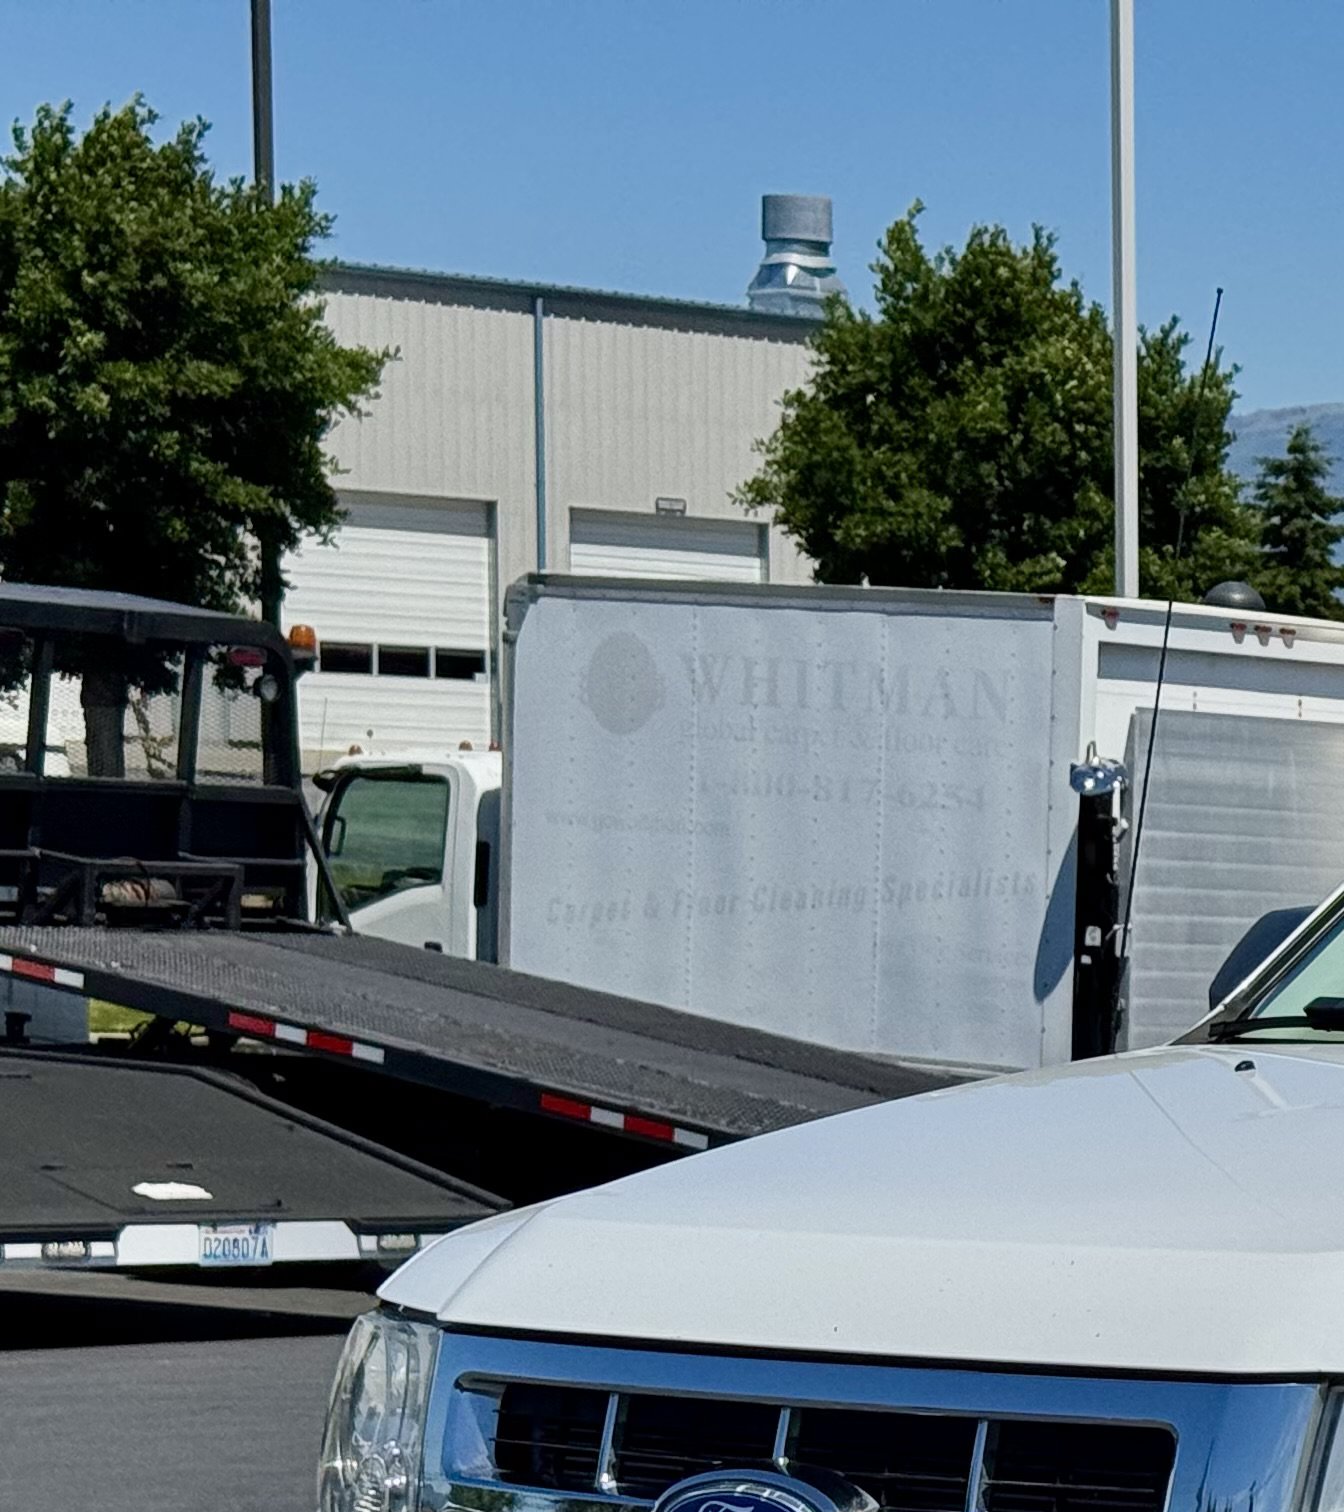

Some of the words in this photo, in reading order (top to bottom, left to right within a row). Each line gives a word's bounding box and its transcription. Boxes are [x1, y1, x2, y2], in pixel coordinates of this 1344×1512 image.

[682, 653, 1012, 722] WHITMAN
[546, 894, 632, 930] Carpet
[642, 891, 660, 920] &
[671, 889, 740, 918] Foor
[751, 879, 868, 914] Cleaning
[881, 867, 1038, 911] Specialists
